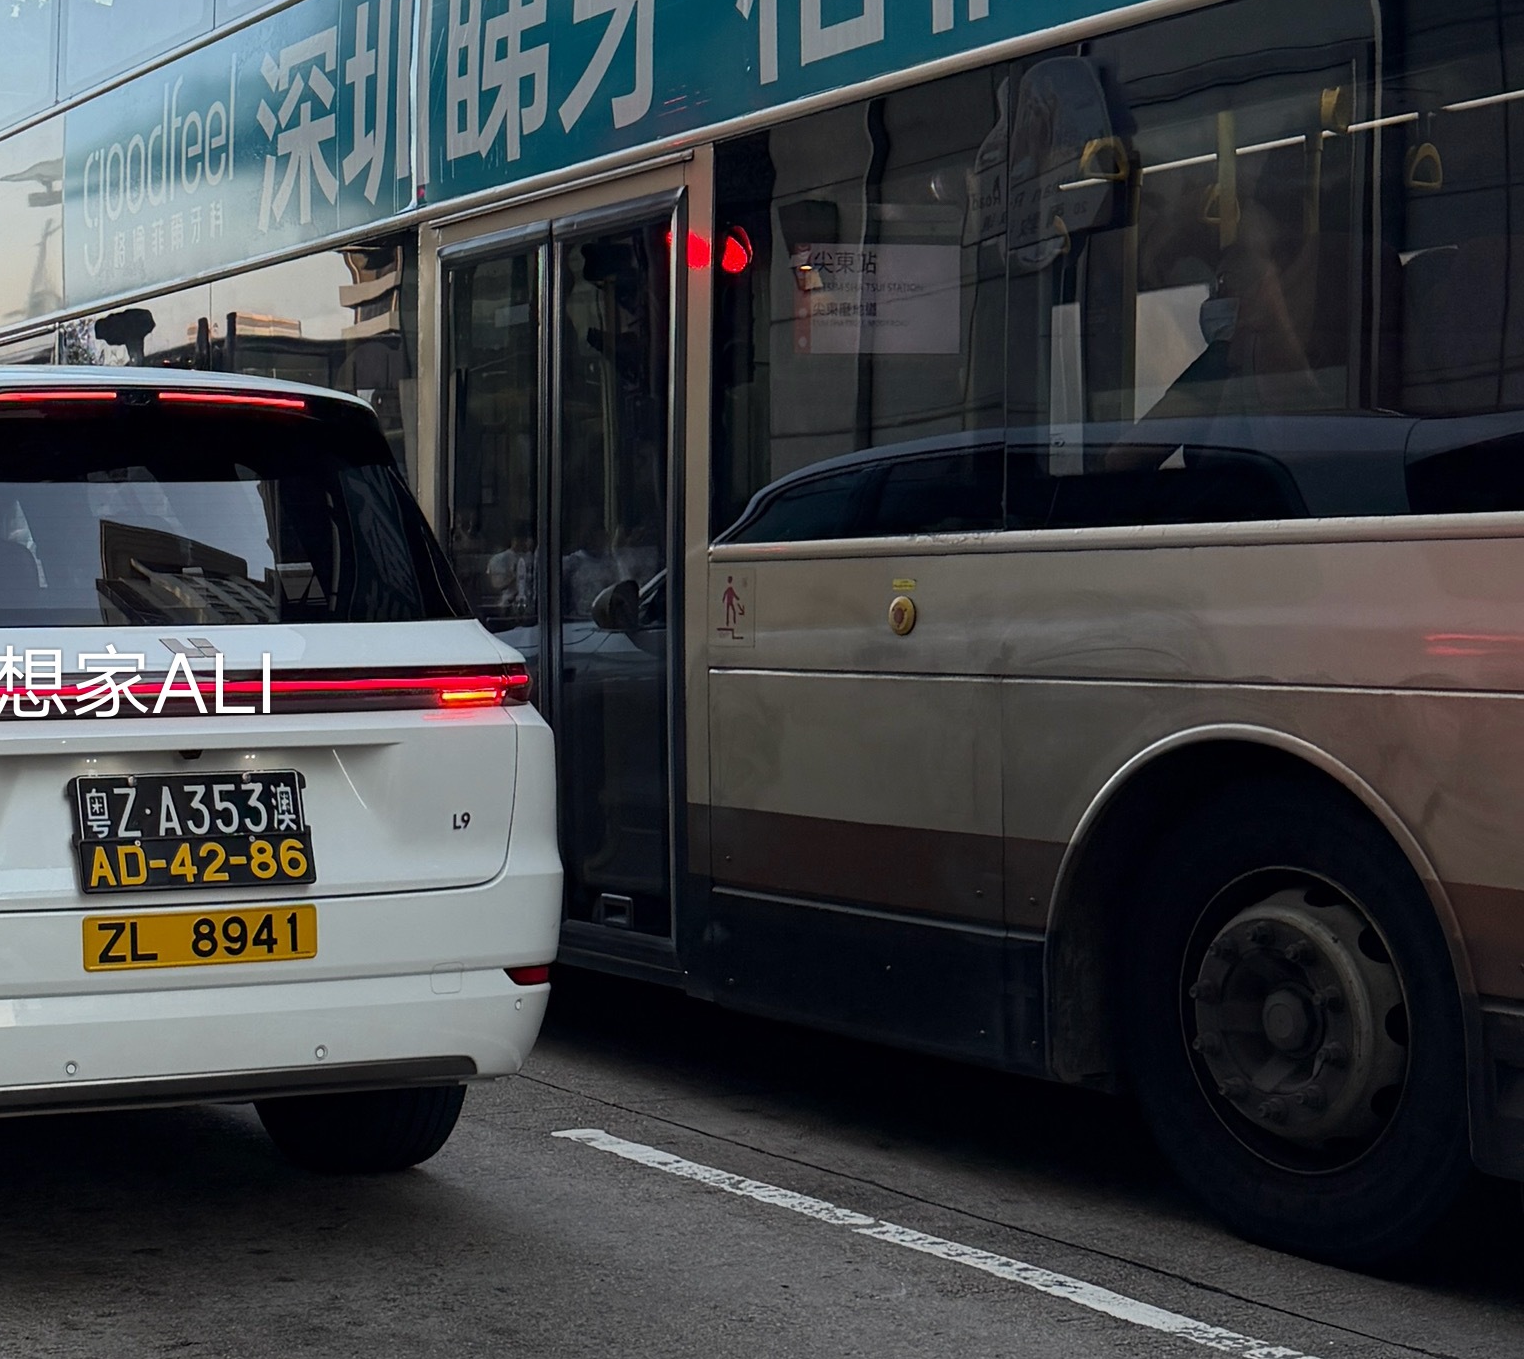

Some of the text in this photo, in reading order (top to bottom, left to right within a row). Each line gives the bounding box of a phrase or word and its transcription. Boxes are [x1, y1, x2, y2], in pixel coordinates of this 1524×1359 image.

[84, 52, 237, 276] goodfeel
[453, 812, 471, 830] L9
[90, 838, 307, 887] AD-42-86
[98, 912, 299, 964] ZL 8941
